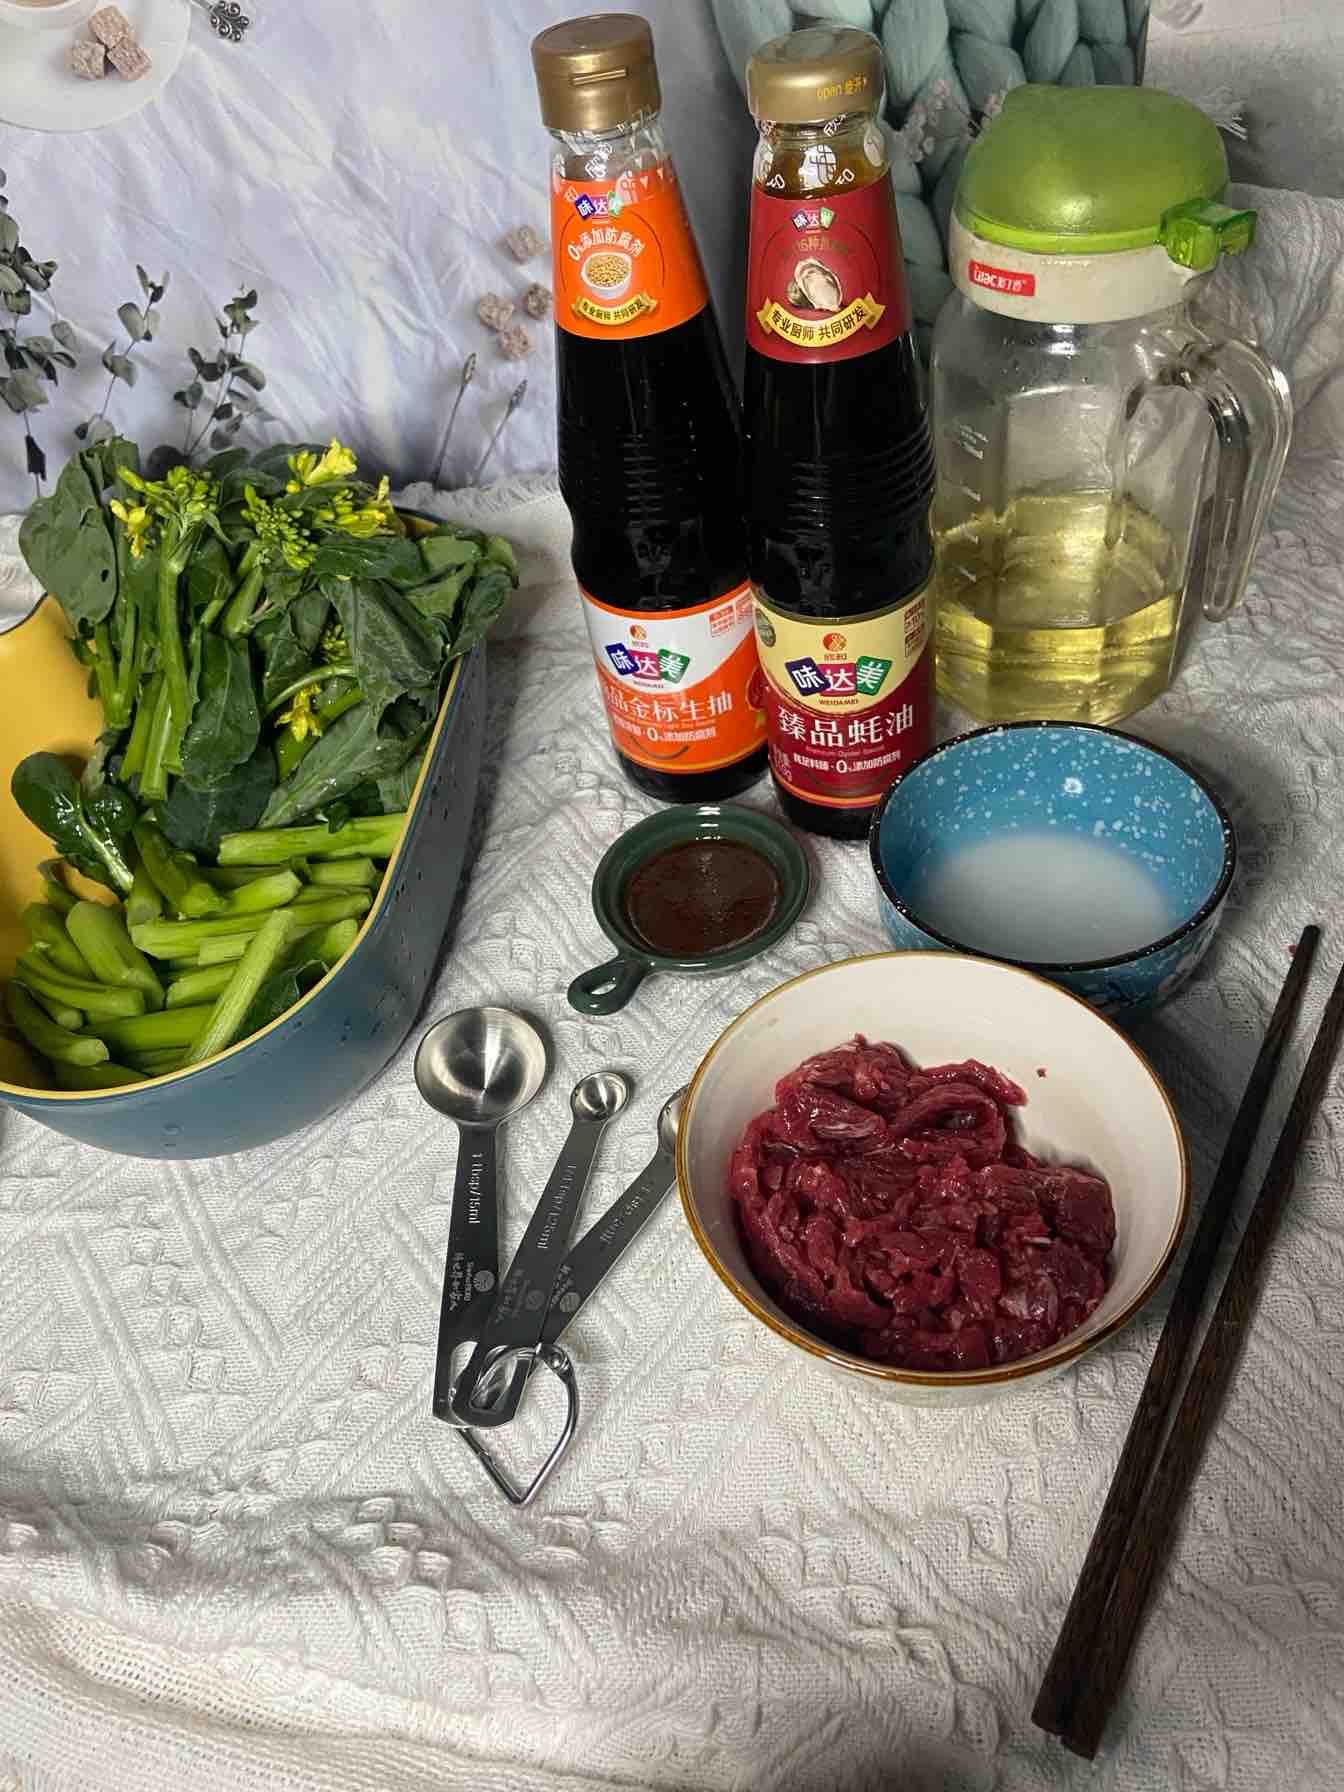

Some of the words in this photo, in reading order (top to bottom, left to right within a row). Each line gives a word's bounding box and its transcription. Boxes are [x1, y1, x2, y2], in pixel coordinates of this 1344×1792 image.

[771, 309, 815, 341] 专业厨师
[818, 304, 866, 341] 共同研发
[608, 645, 688, 681] 味达美
[789, 659, 887, 692] 味达美
[777, 703, 913, 748] 臻品蚝油
